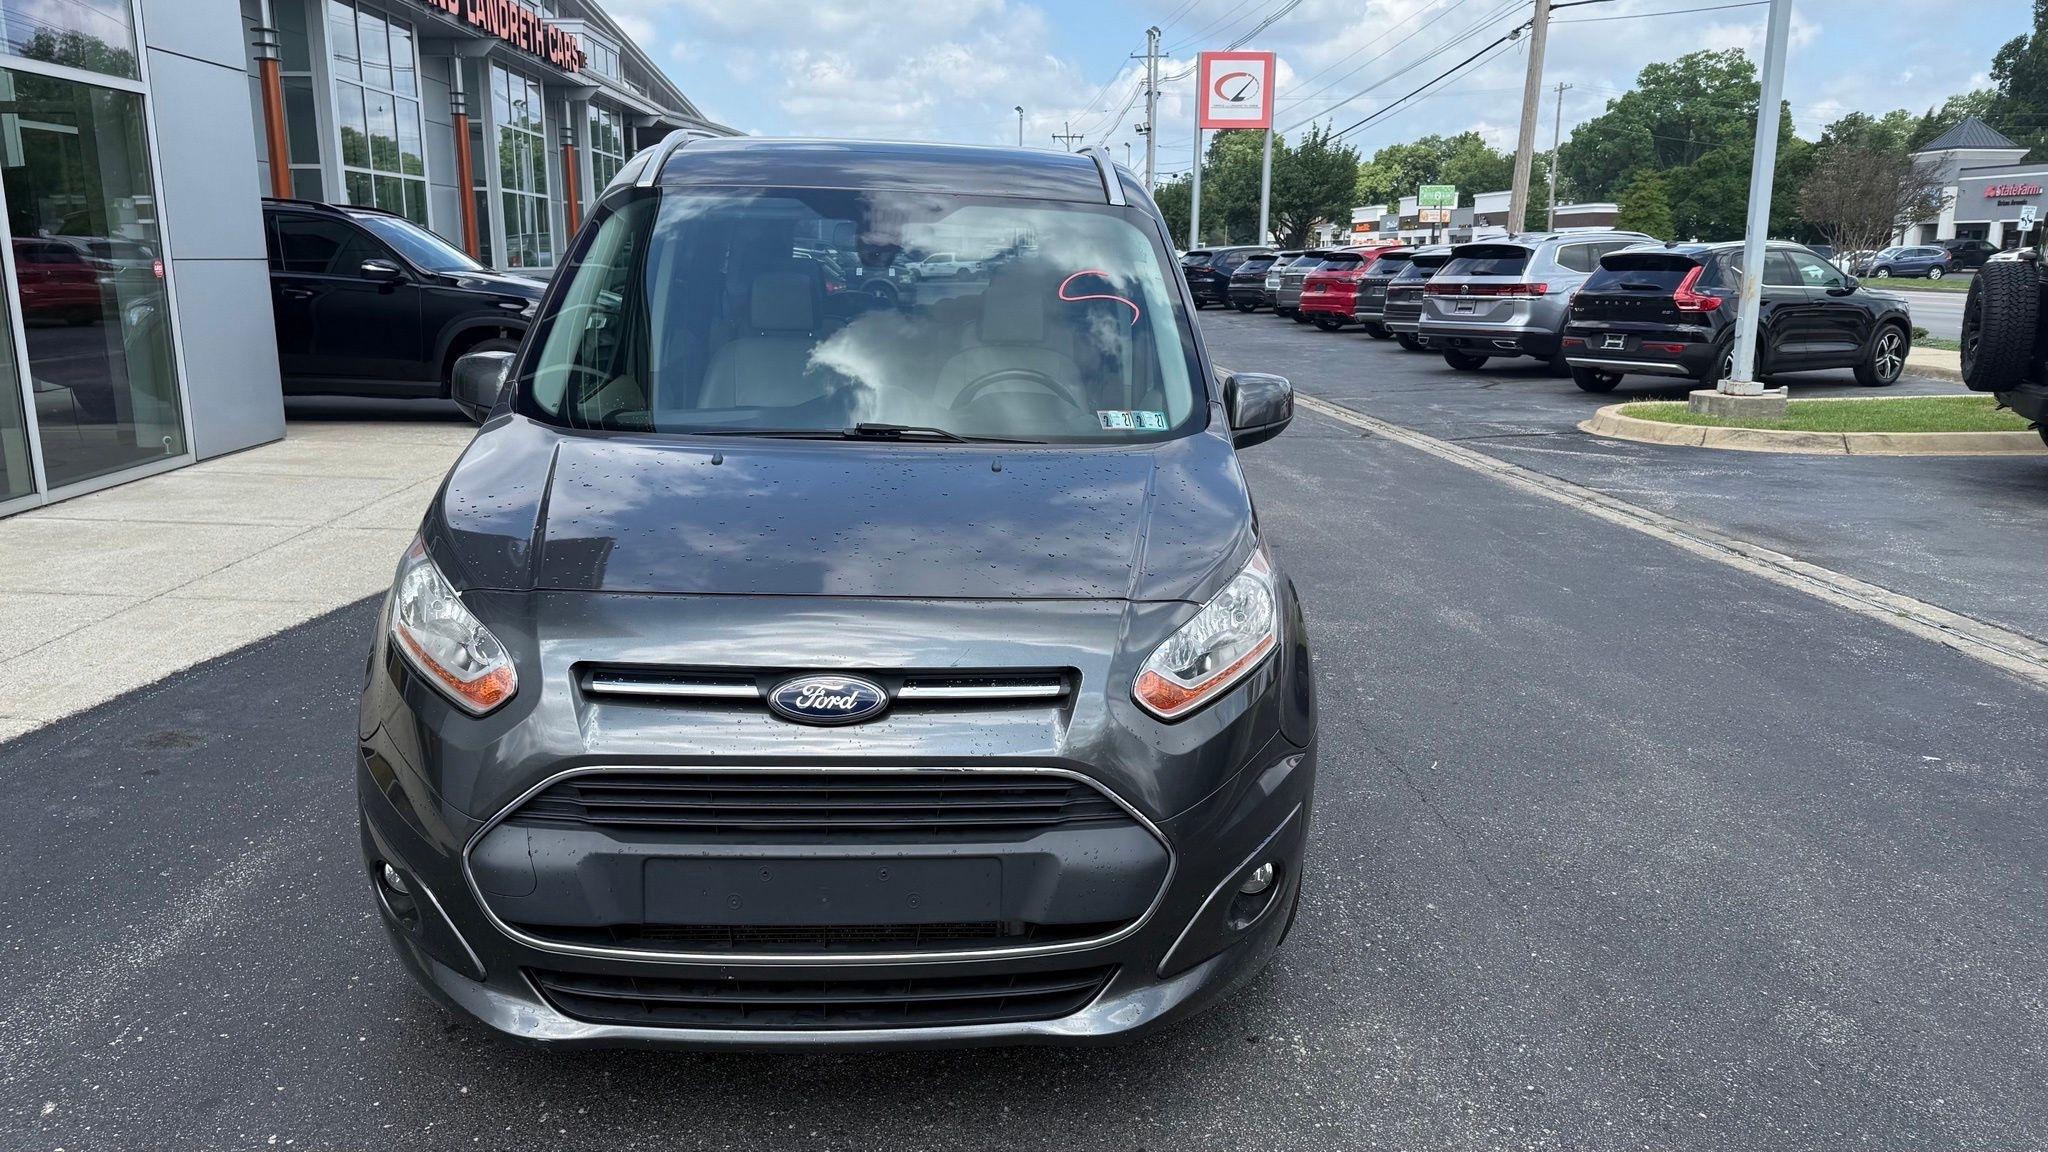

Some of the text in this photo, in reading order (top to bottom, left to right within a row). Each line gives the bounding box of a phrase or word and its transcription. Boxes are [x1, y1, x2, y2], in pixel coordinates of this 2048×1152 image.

[466, 0, 579, 73] LANDRETH CARS
[795, 683, 860, 710] Ford
